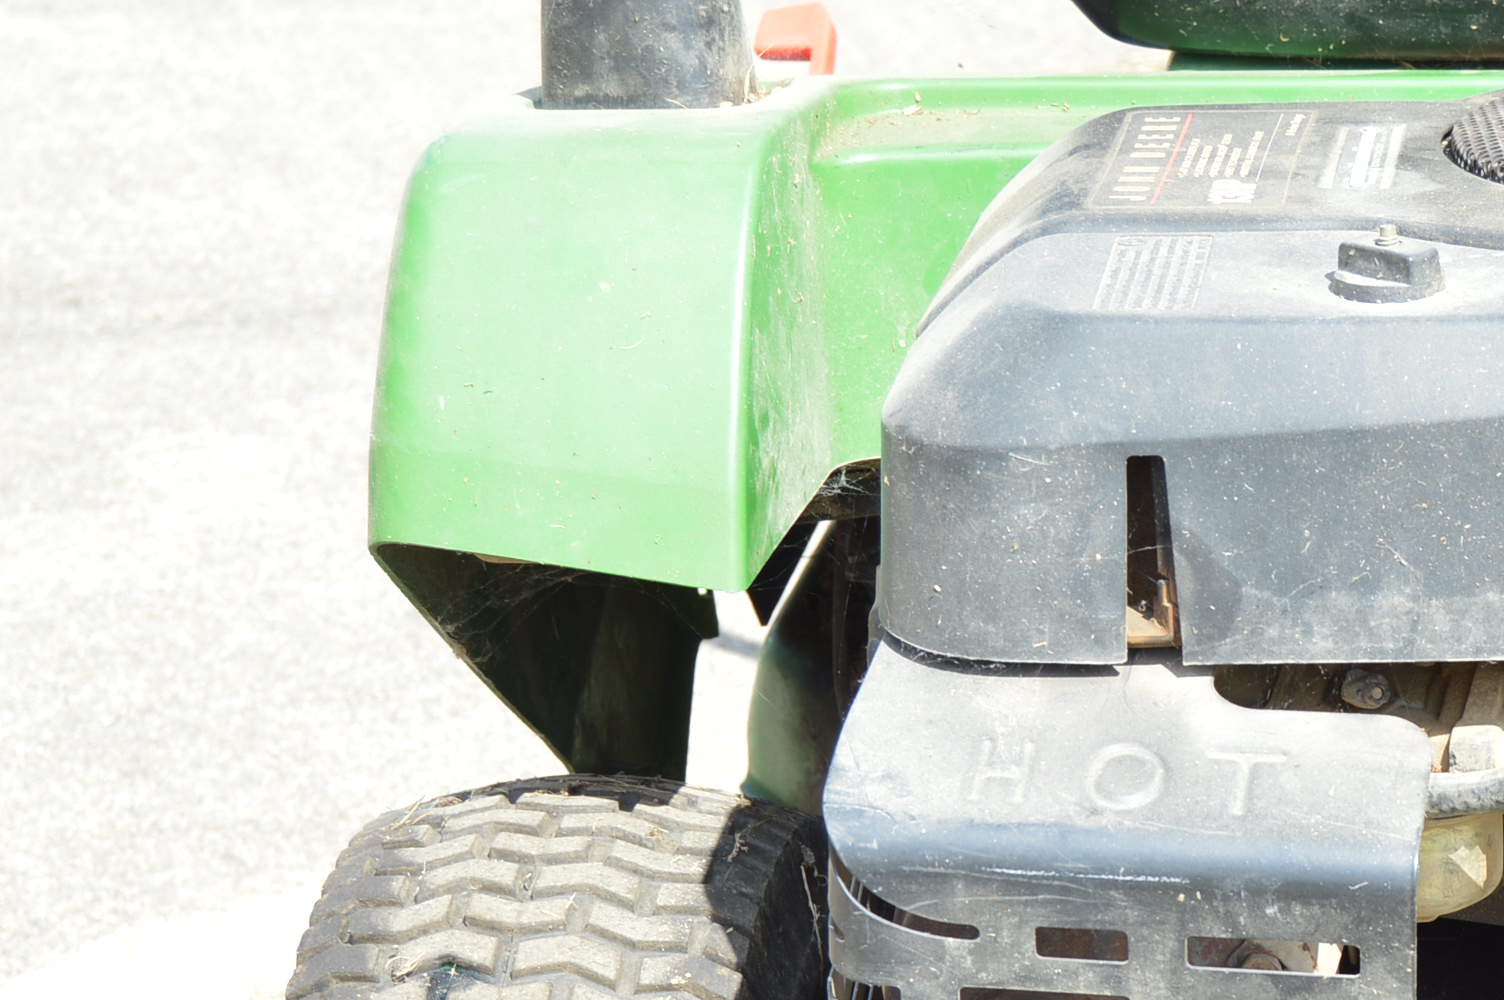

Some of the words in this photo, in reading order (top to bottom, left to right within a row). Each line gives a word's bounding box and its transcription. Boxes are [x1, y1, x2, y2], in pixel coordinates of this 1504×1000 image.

[1129, 117, 1181, 158] DEERE
[1109, 166, 1161, 201] JOHN
[969, 738, 1288, 816] HOT
